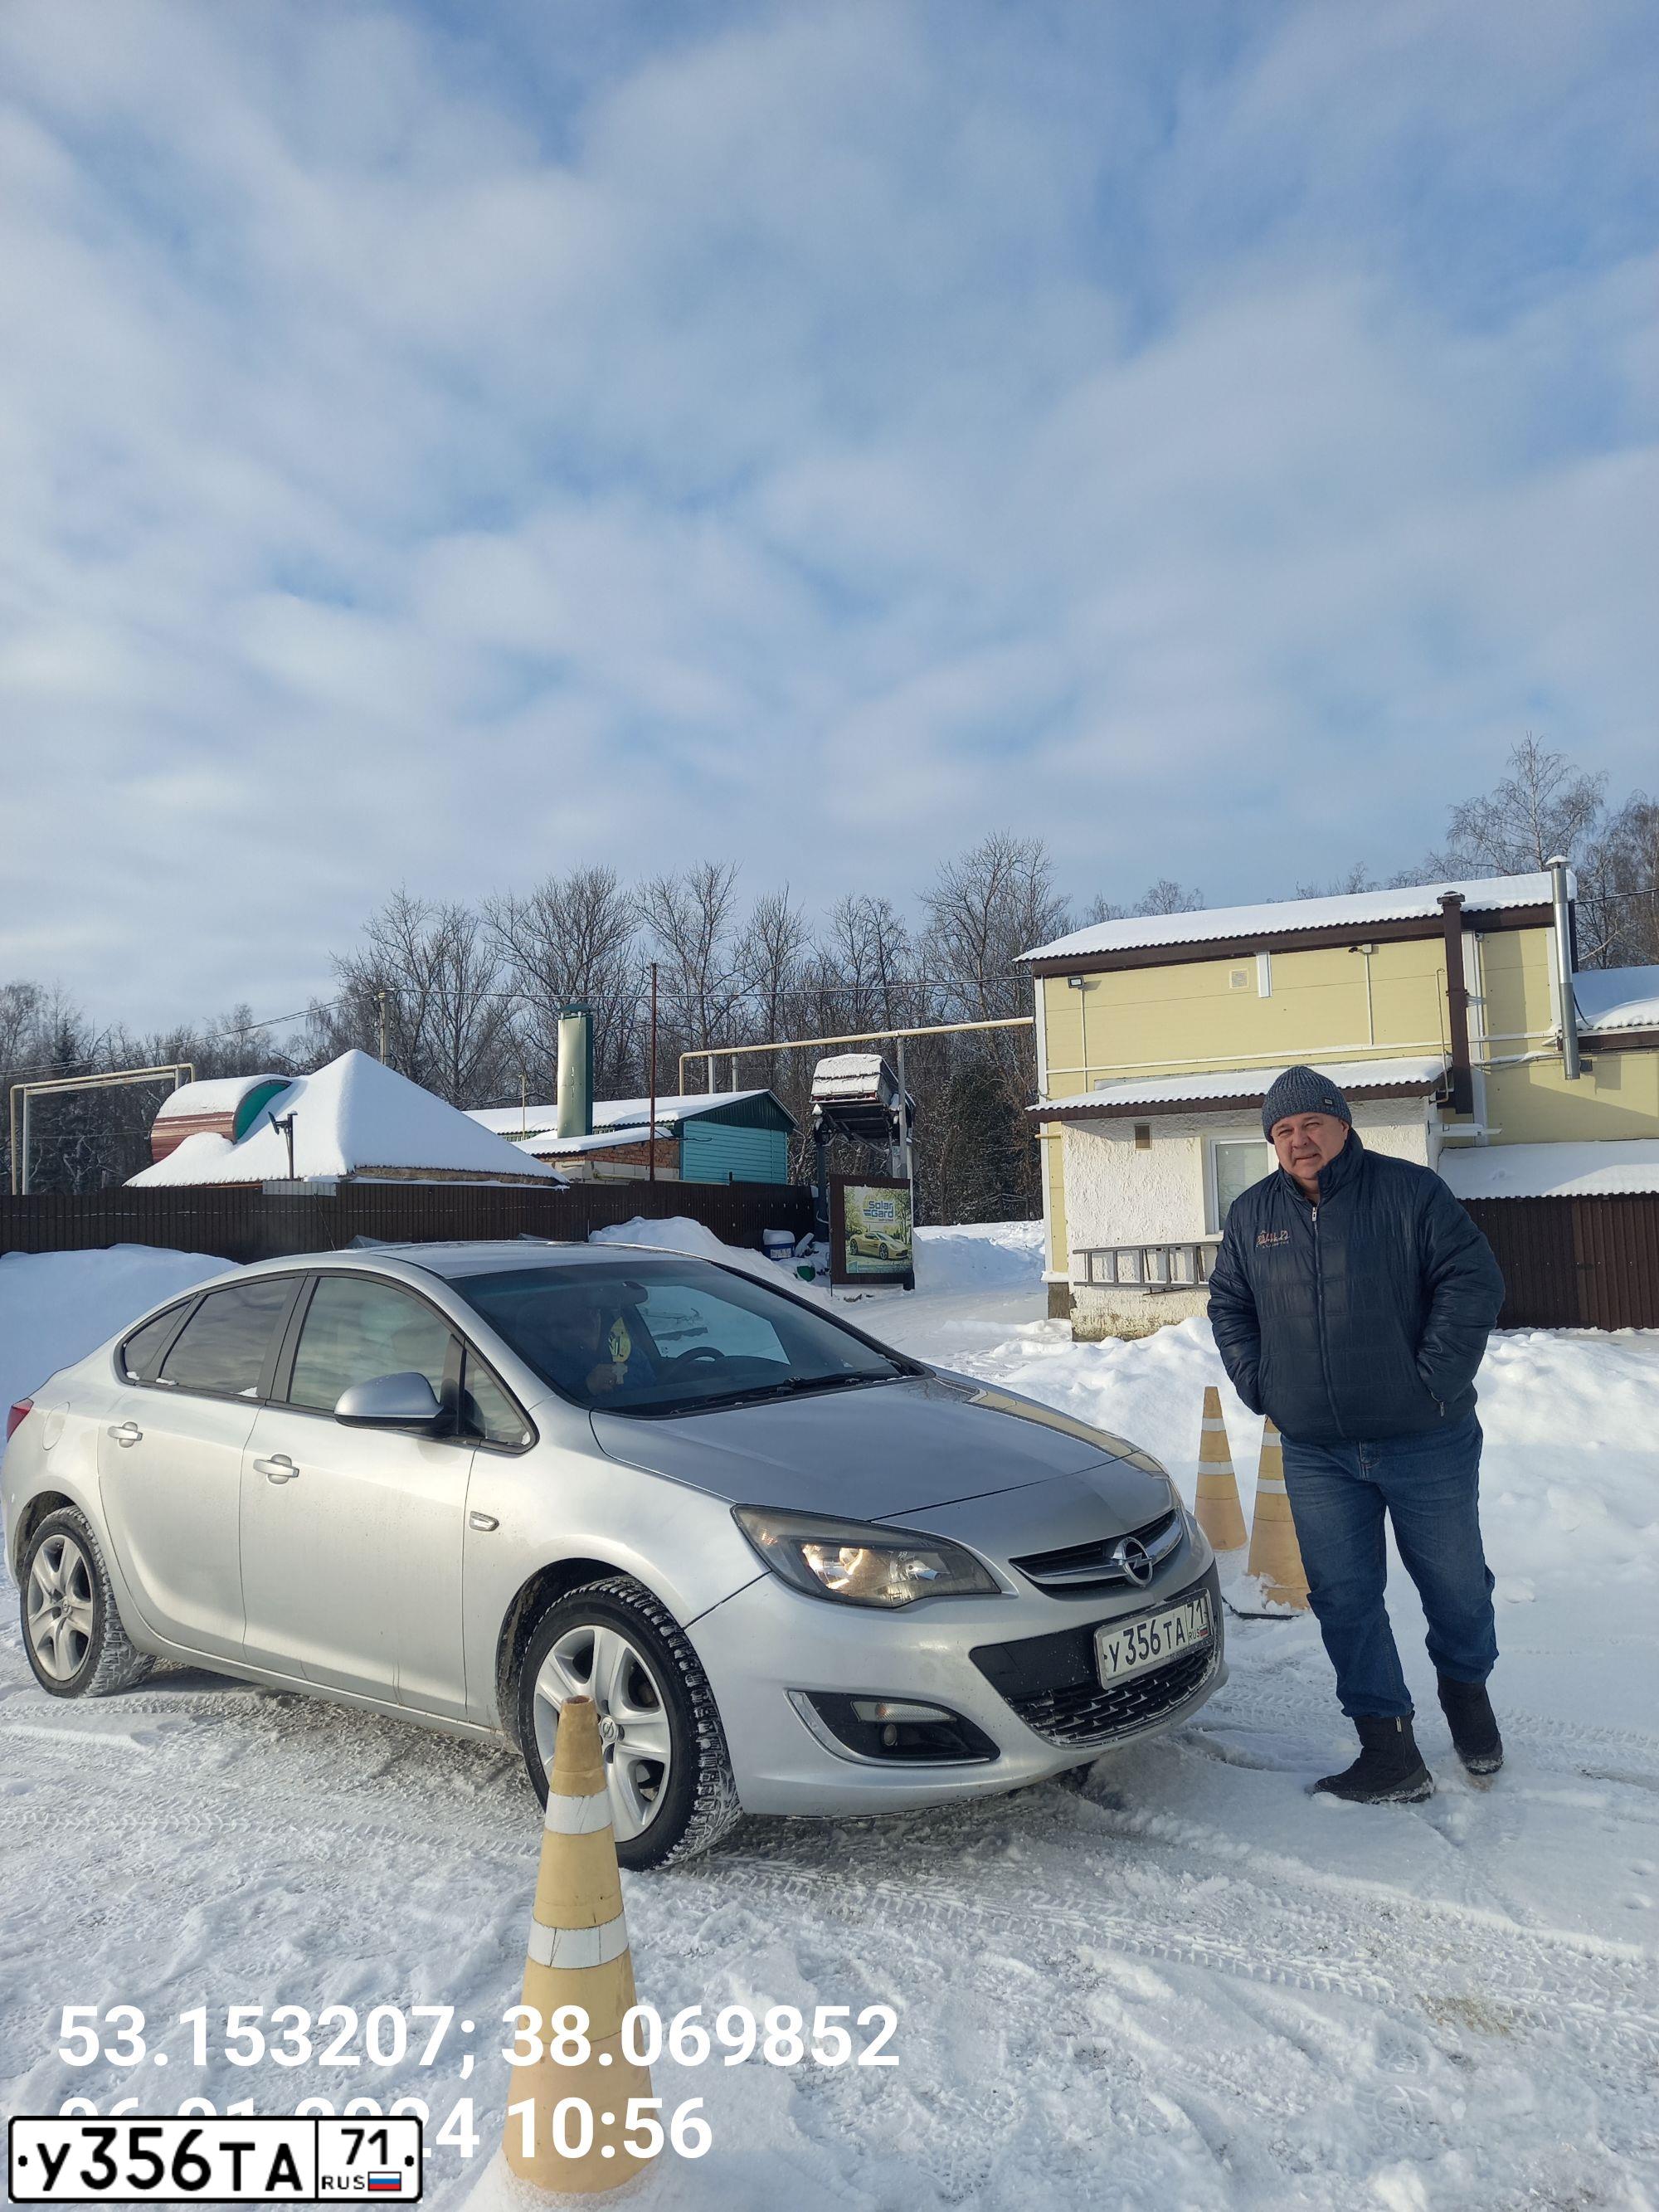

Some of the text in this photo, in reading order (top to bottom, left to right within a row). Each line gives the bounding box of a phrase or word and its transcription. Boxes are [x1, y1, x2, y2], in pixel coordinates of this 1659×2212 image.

[868, 1200, 893, 1211] Solar
[871, 1206, 894, 1219] Gard
[1186, 1599, 1204, 1630] 71
[1188, 1630, 1200, 1643] RUS
